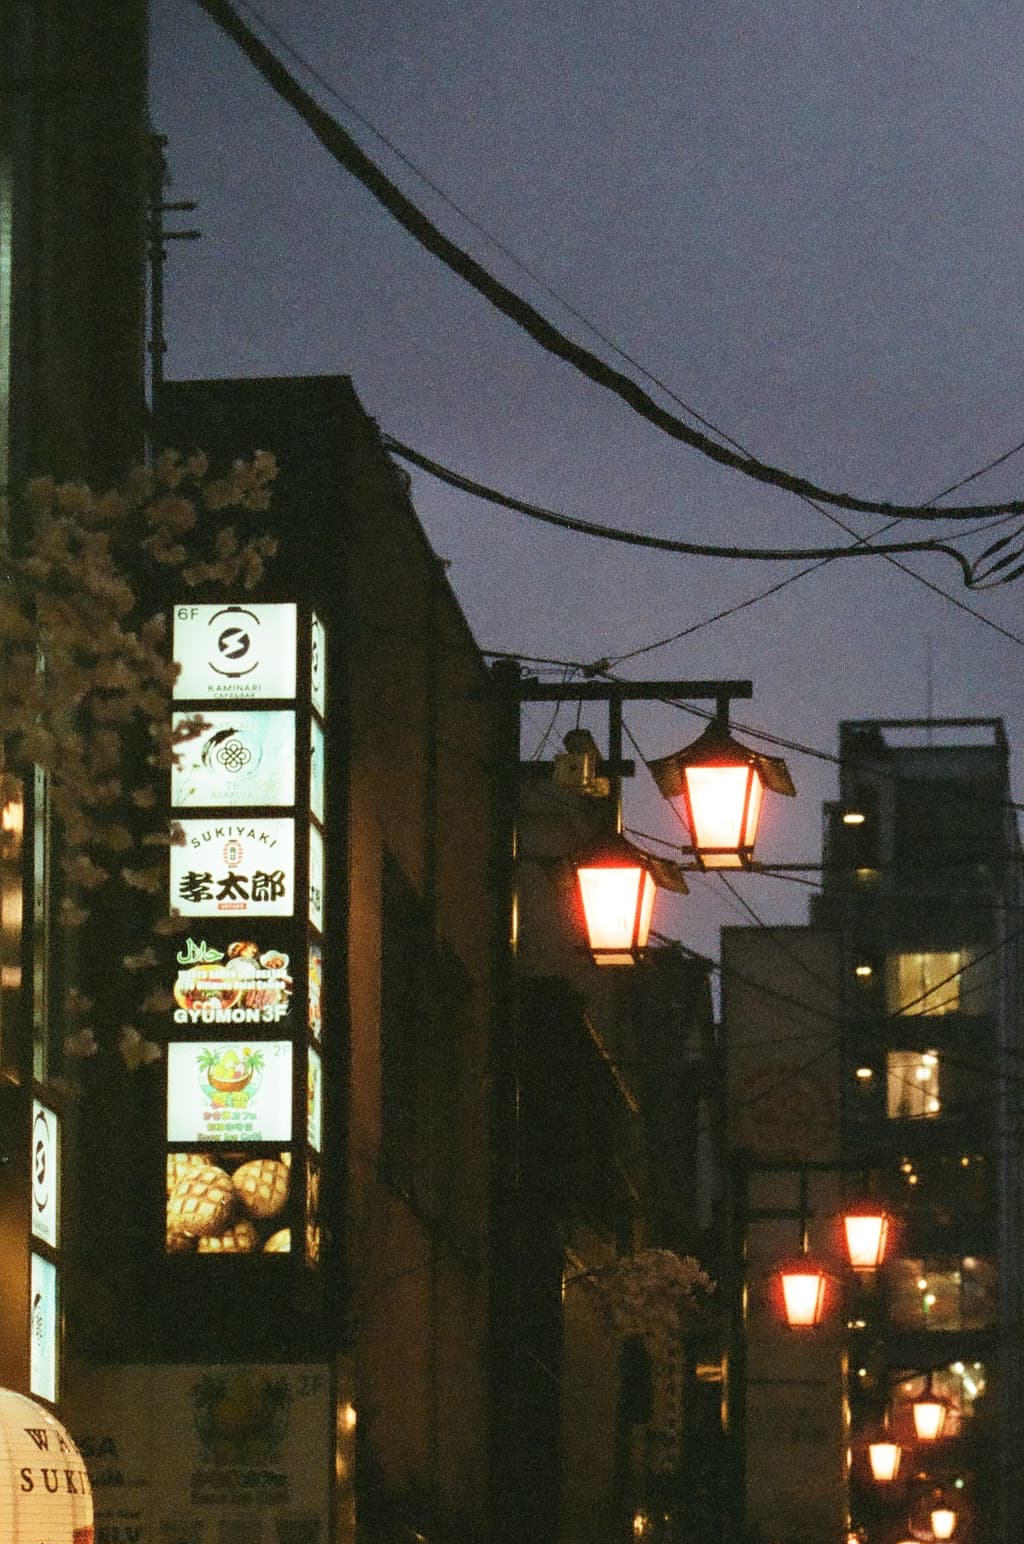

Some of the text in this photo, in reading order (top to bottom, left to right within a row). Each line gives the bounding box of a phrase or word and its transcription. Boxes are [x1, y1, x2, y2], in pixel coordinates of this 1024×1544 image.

[177, 607, 199, 620] 6F
[190, 826, 277, 849] SUKIYAKI
[179, 869, 286, 902] 孝太郎
[176, 937, 225, 965] حلال
[173, 1003, 289, 1023] GYUMON 3F
[272, 1045, 290, 1057] 2F
[20, 1467, 90, 1495] SUKI
